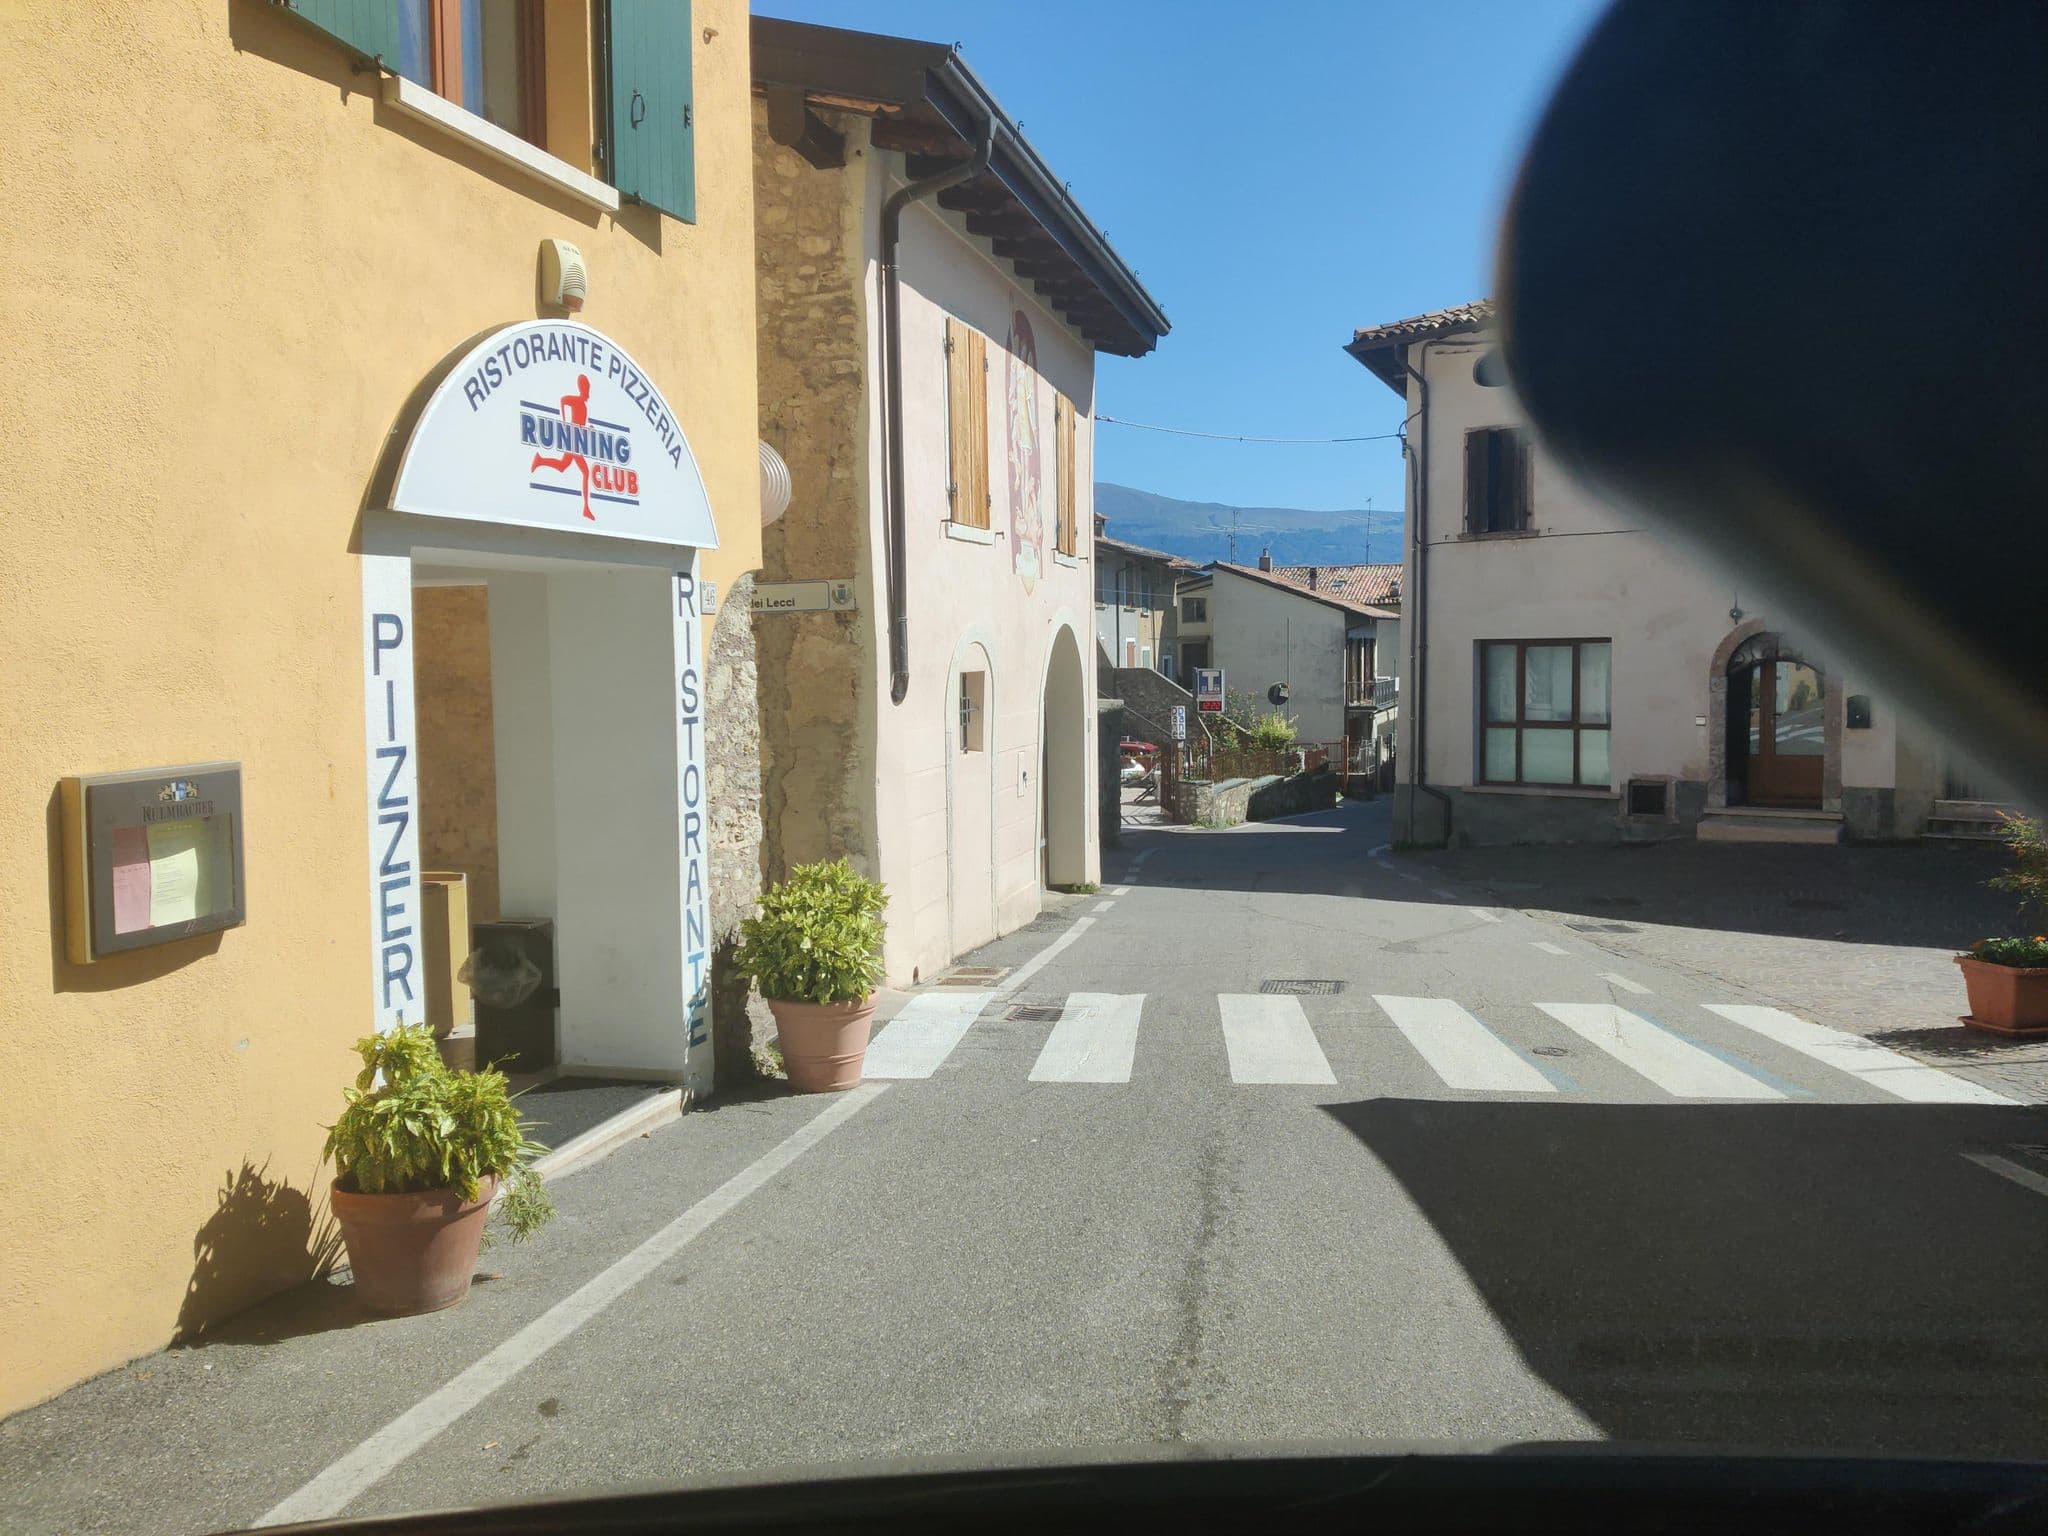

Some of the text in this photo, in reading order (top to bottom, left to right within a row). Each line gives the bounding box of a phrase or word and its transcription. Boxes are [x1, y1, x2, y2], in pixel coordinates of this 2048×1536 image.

[463, 332, 682, 470] RISTORANTE PIZZERIA
[521, 413, 631, 464] RUNNING
[592, 465, 639, 496] CLUB
[766, 597, 795, 608] Lecci
[372, 614, 414, 1025] PIZZER
[677, 571, 708, 1048] RISTORANTE
